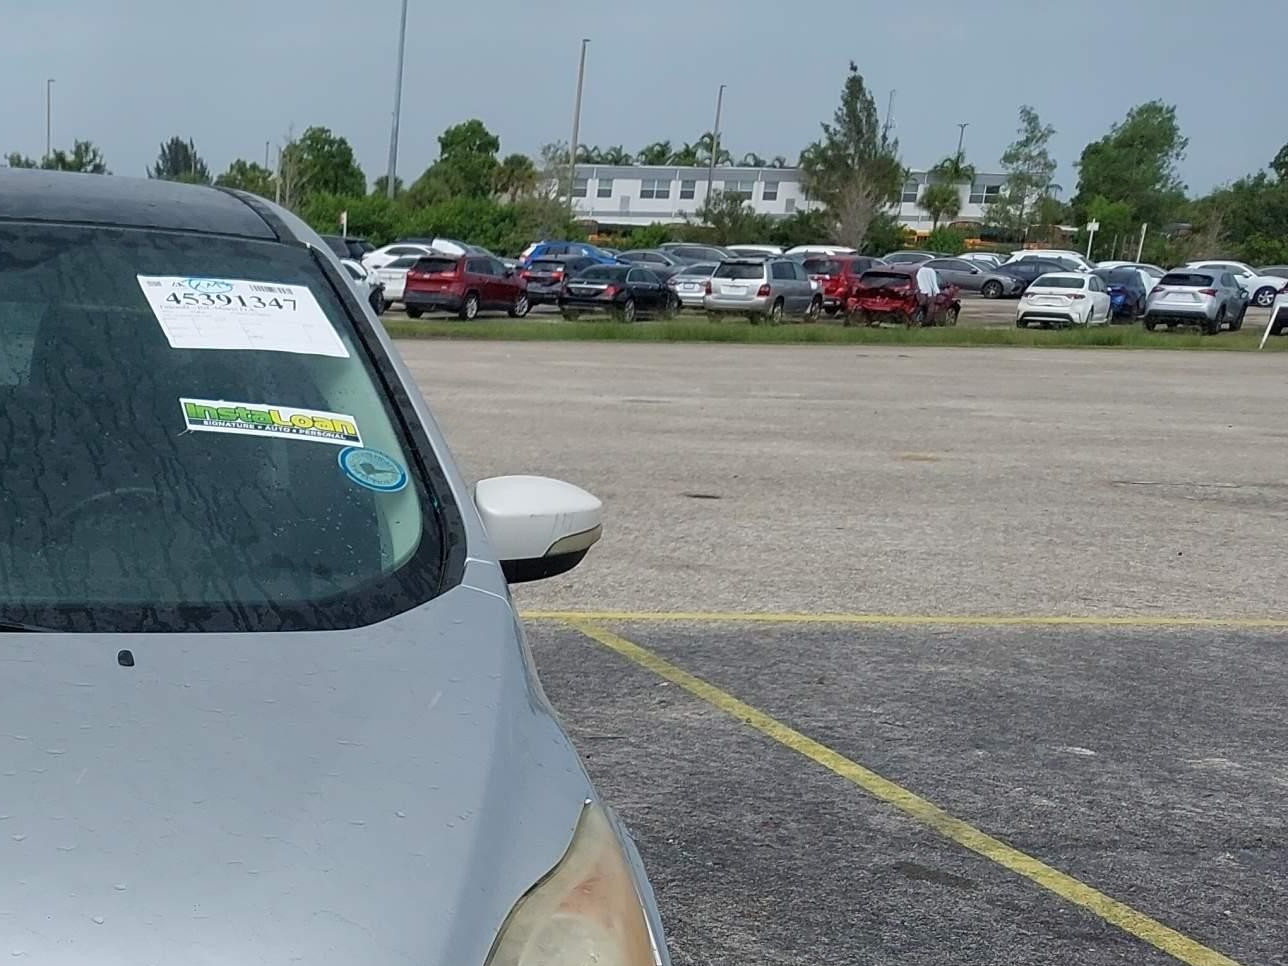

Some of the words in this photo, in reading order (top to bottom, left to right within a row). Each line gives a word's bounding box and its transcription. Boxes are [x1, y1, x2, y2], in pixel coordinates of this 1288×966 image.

[166, 292, 297, 311] 45391347
[185, 402, 357, 436] InstaLoan
[203, 420, 255, 430] SIGNATURE
[264, 425, 290, 433] AUTO
[298, 429, 346, 440] PERSONAL
